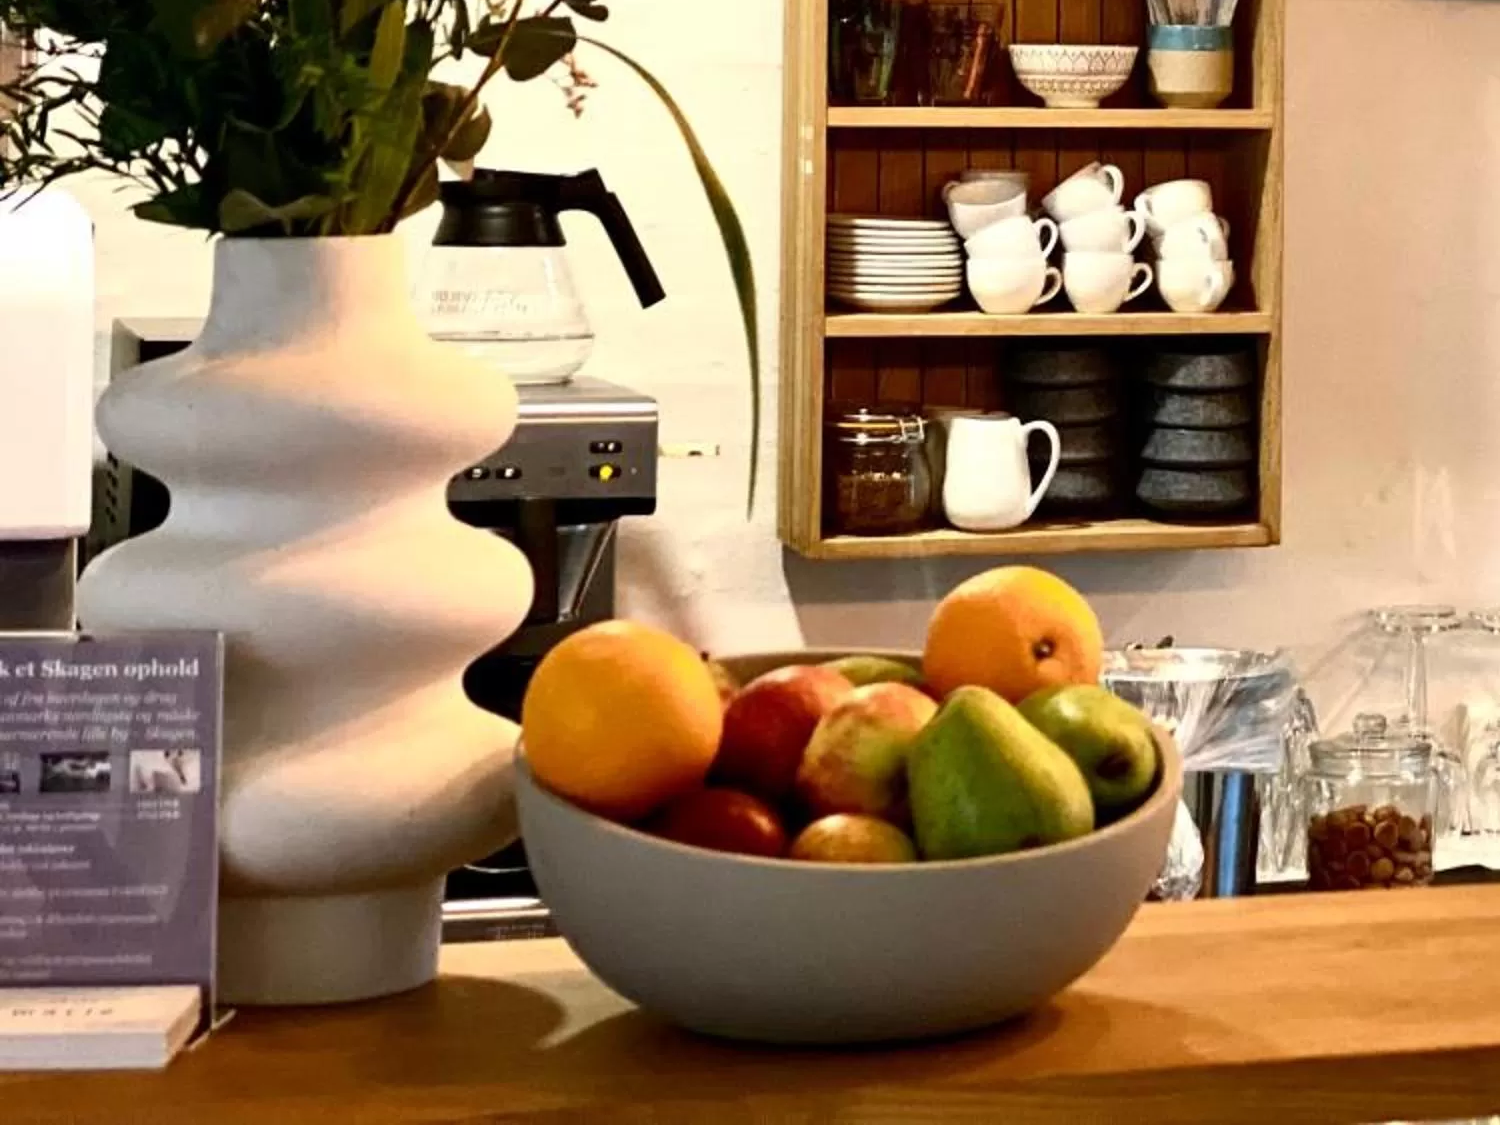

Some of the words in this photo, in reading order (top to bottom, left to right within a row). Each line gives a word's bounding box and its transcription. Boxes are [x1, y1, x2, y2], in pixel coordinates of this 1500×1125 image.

[15, 661, 34, 677] et
[41, 659, 118, 681] Skagen
[123, 657, 200, 682] ophold
